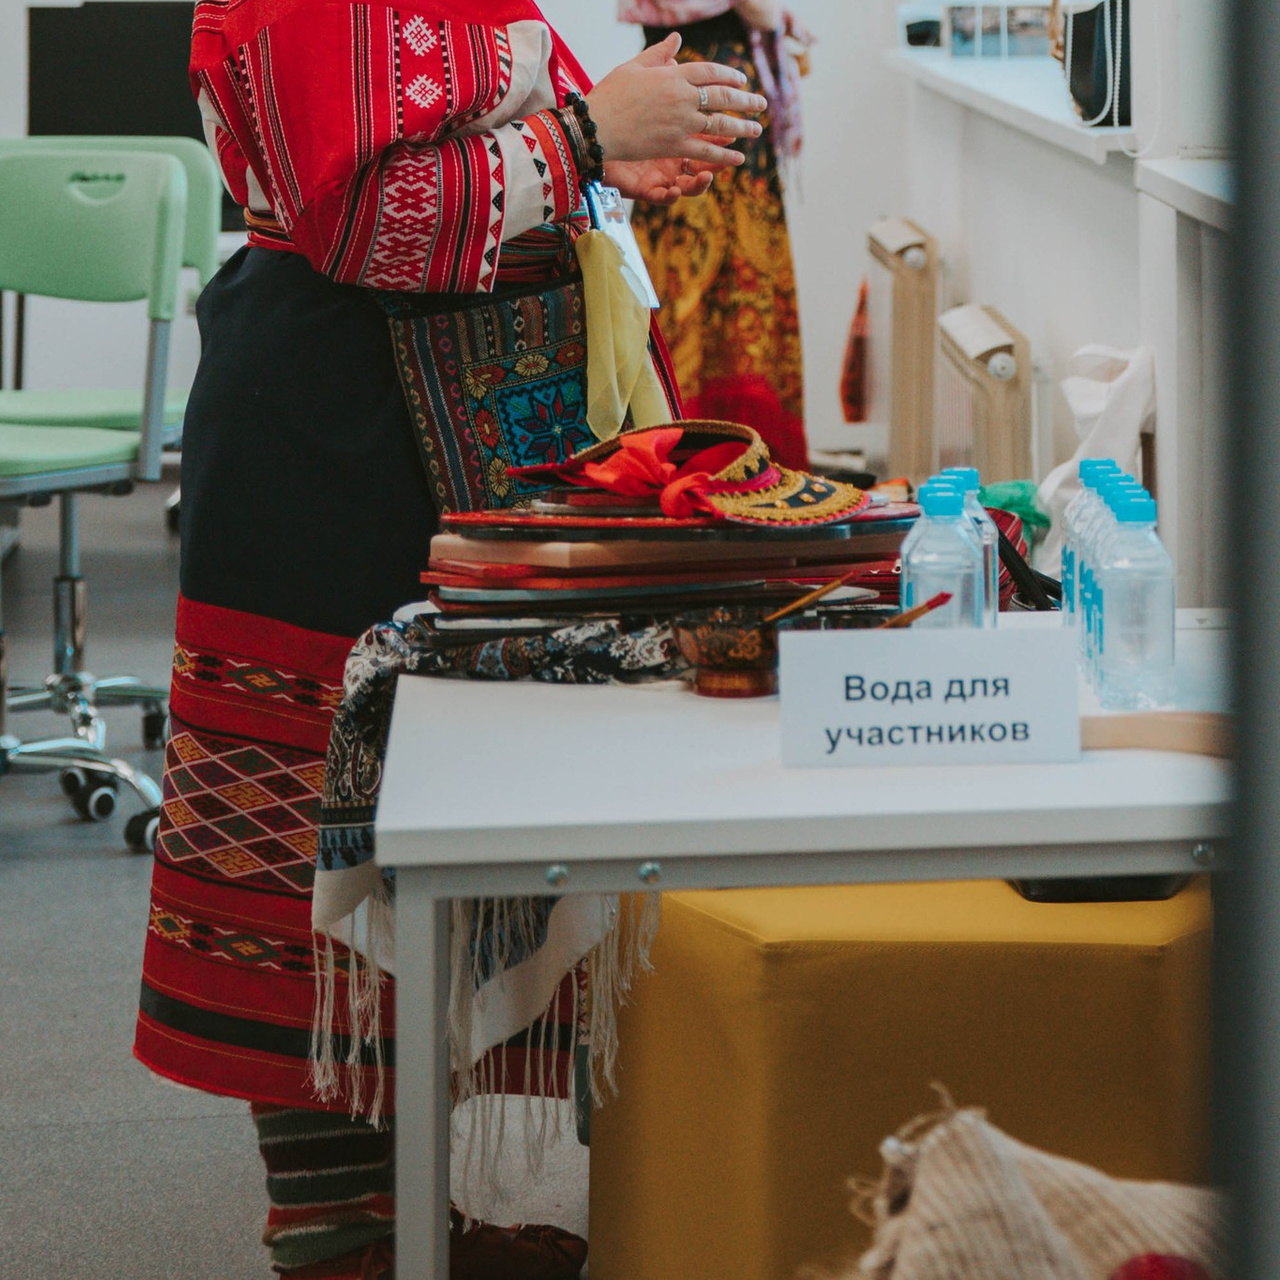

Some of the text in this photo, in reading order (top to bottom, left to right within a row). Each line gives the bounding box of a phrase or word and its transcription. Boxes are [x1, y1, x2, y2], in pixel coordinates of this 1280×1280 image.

[844, 674, 1010, 705] Вода для
[825, 722, 1030, 755] участников
